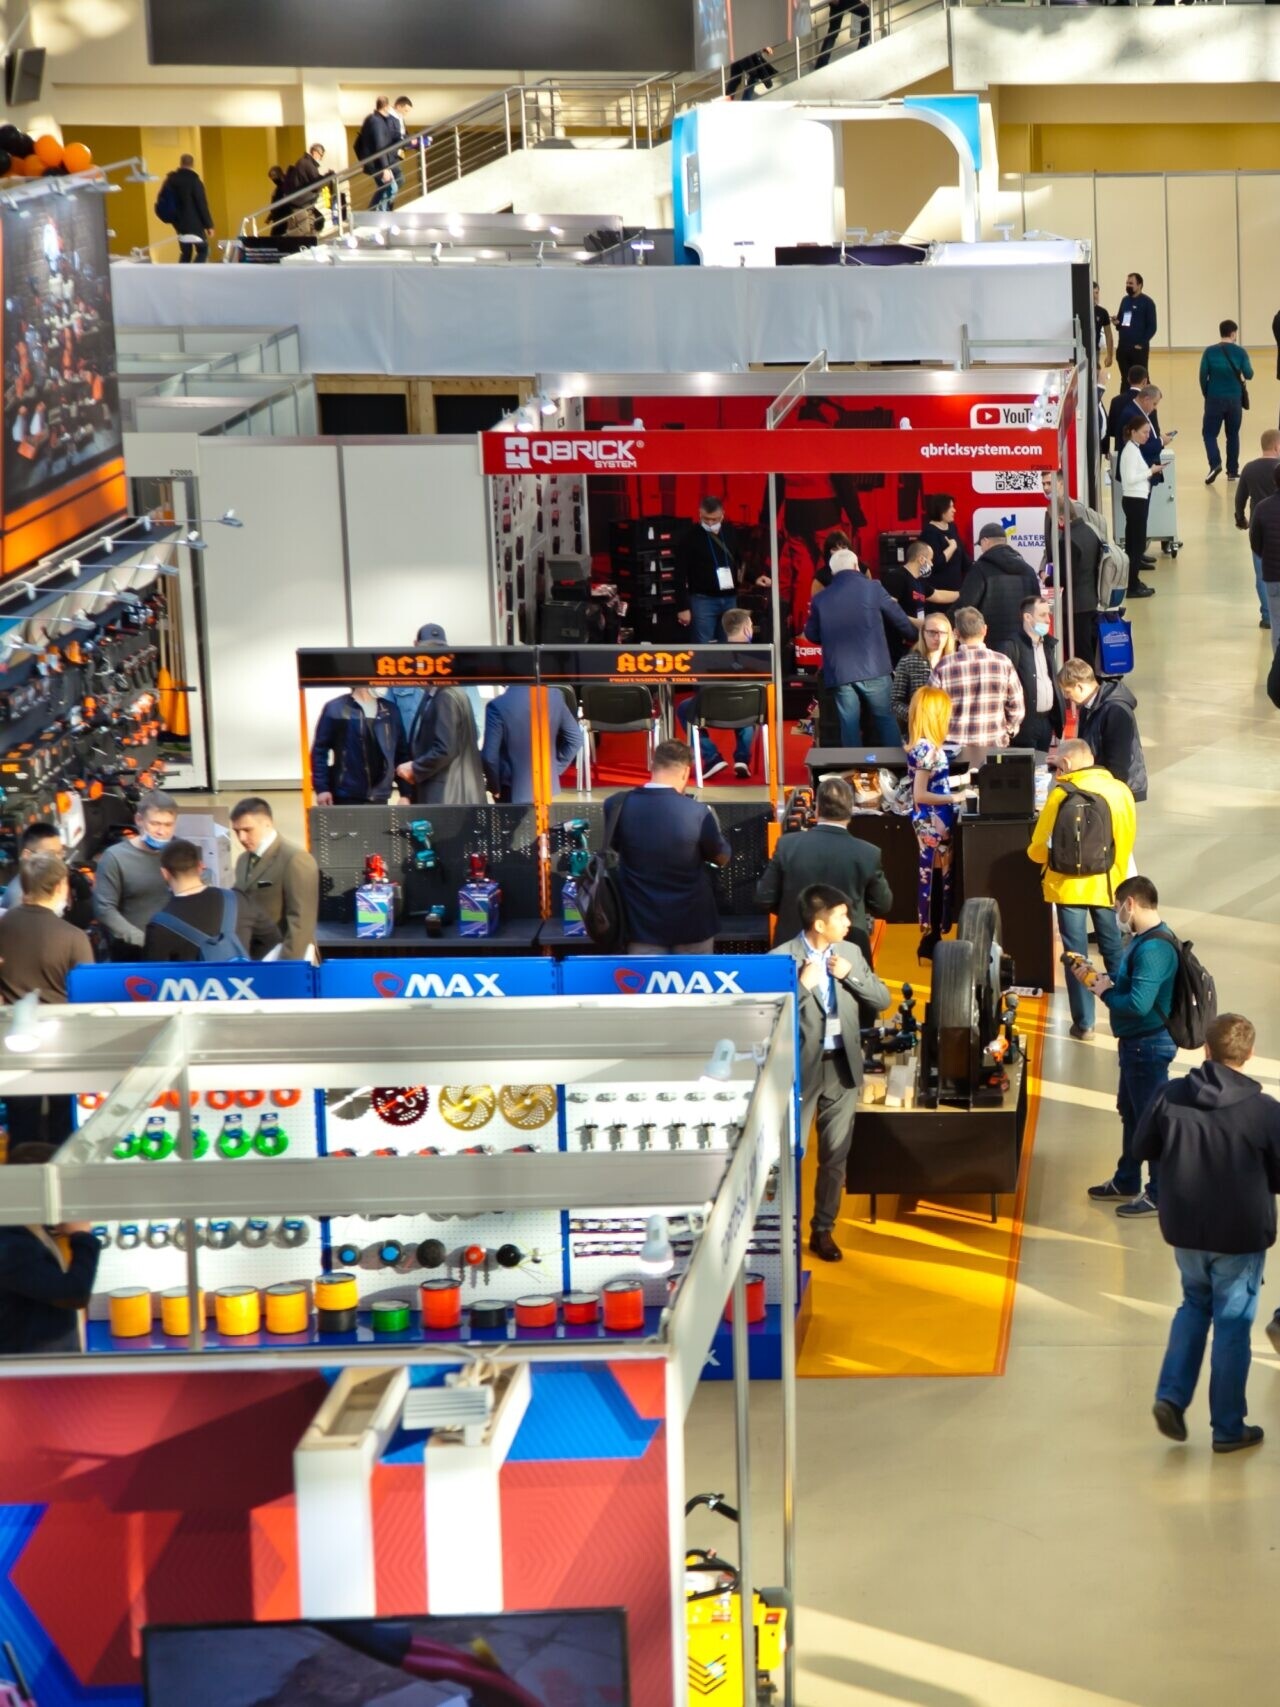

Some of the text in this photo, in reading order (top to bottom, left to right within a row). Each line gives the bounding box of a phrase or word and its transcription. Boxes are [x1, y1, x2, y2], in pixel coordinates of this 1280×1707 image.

[532, 440, 636, 464] QBRICK
[920, 443, 1042, 458] qbricksystem.com
[594, 460, 637, 469] SYSTEM
[616, 652, 691, 673] ACDC
[799, 647, 823, 657] QBR
[376, 655, 452, 676] ACDC
[158, 977, 260, 1000] MAX
[404, 973, 504, 997] MAX
[645, 971, 744, 994] MAX
